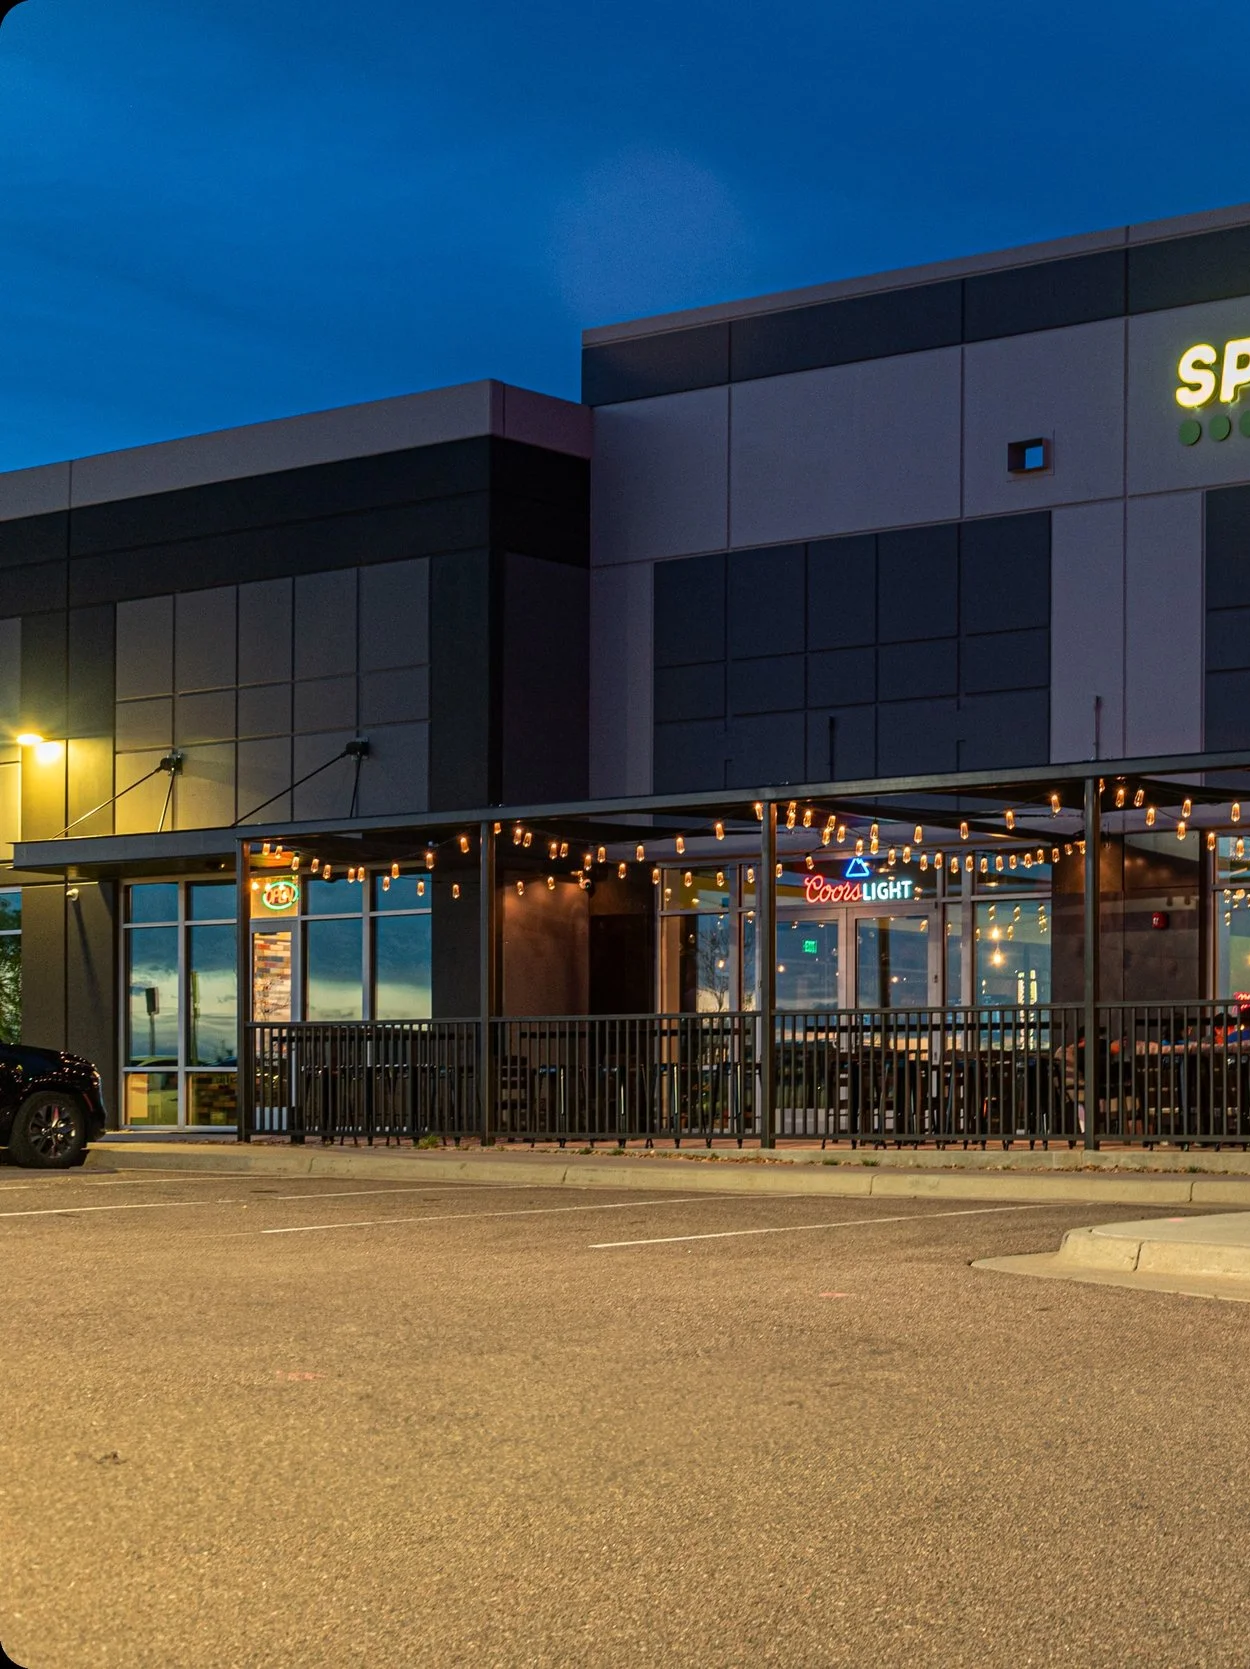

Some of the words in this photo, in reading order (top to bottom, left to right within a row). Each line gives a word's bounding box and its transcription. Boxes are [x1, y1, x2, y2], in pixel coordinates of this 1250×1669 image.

[265, 885, 295, 905] OPEN
[804, 875, 863, 903] Coors
[862, 880, 913, 901] LIGHT
